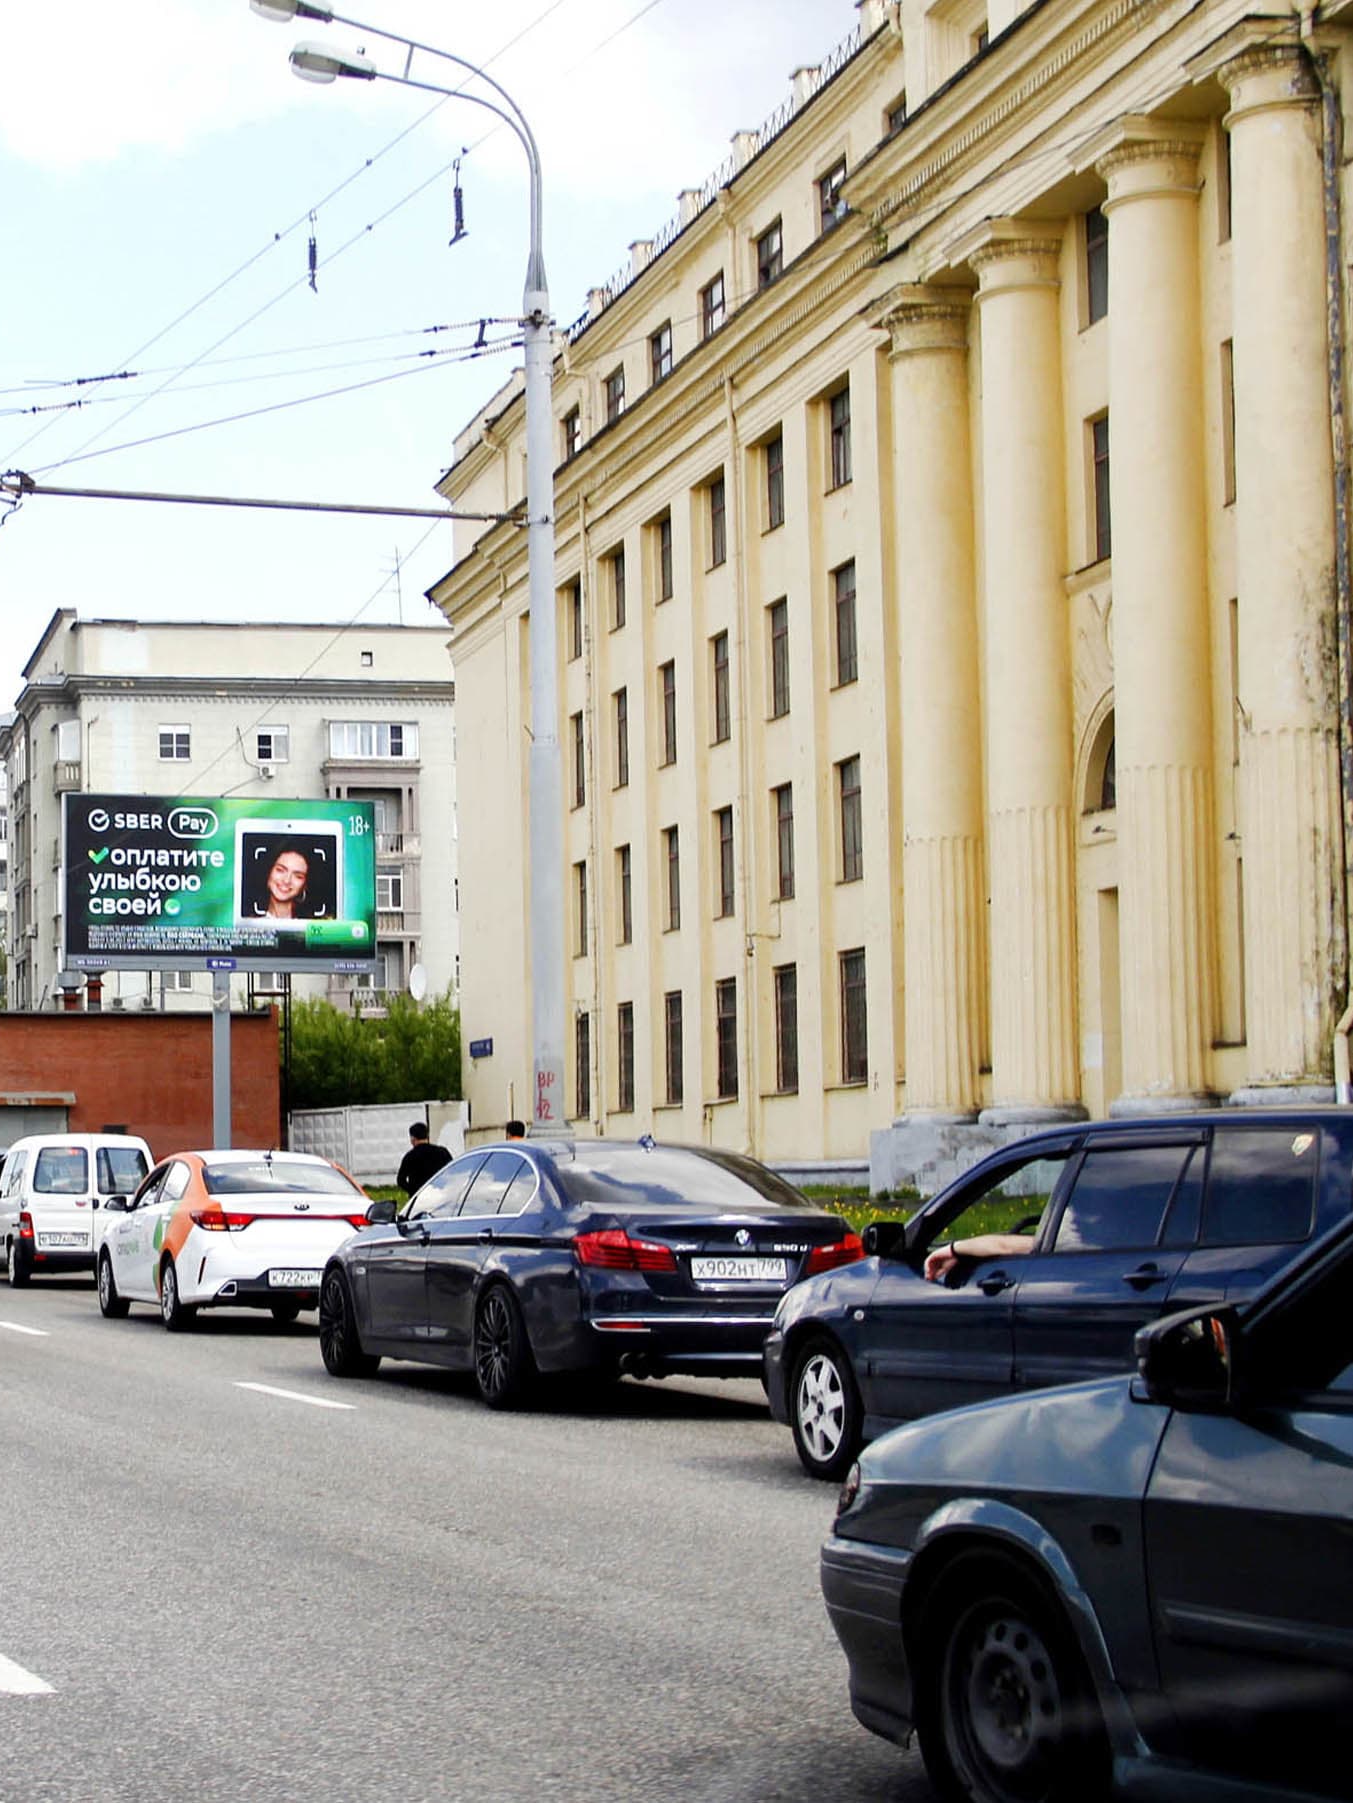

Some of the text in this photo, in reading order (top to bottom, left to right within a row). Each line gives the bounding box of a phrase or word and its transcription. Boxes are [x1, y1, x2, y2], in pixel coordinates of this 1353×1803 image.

[114, 813, 208, 834] SBER Pay
[348, 815, 370, 835] 18+
[110, 848, 225, 867] оплатите
[88, 867, 201, 894] улыбкою
[88, 892, 161, 915] своей
